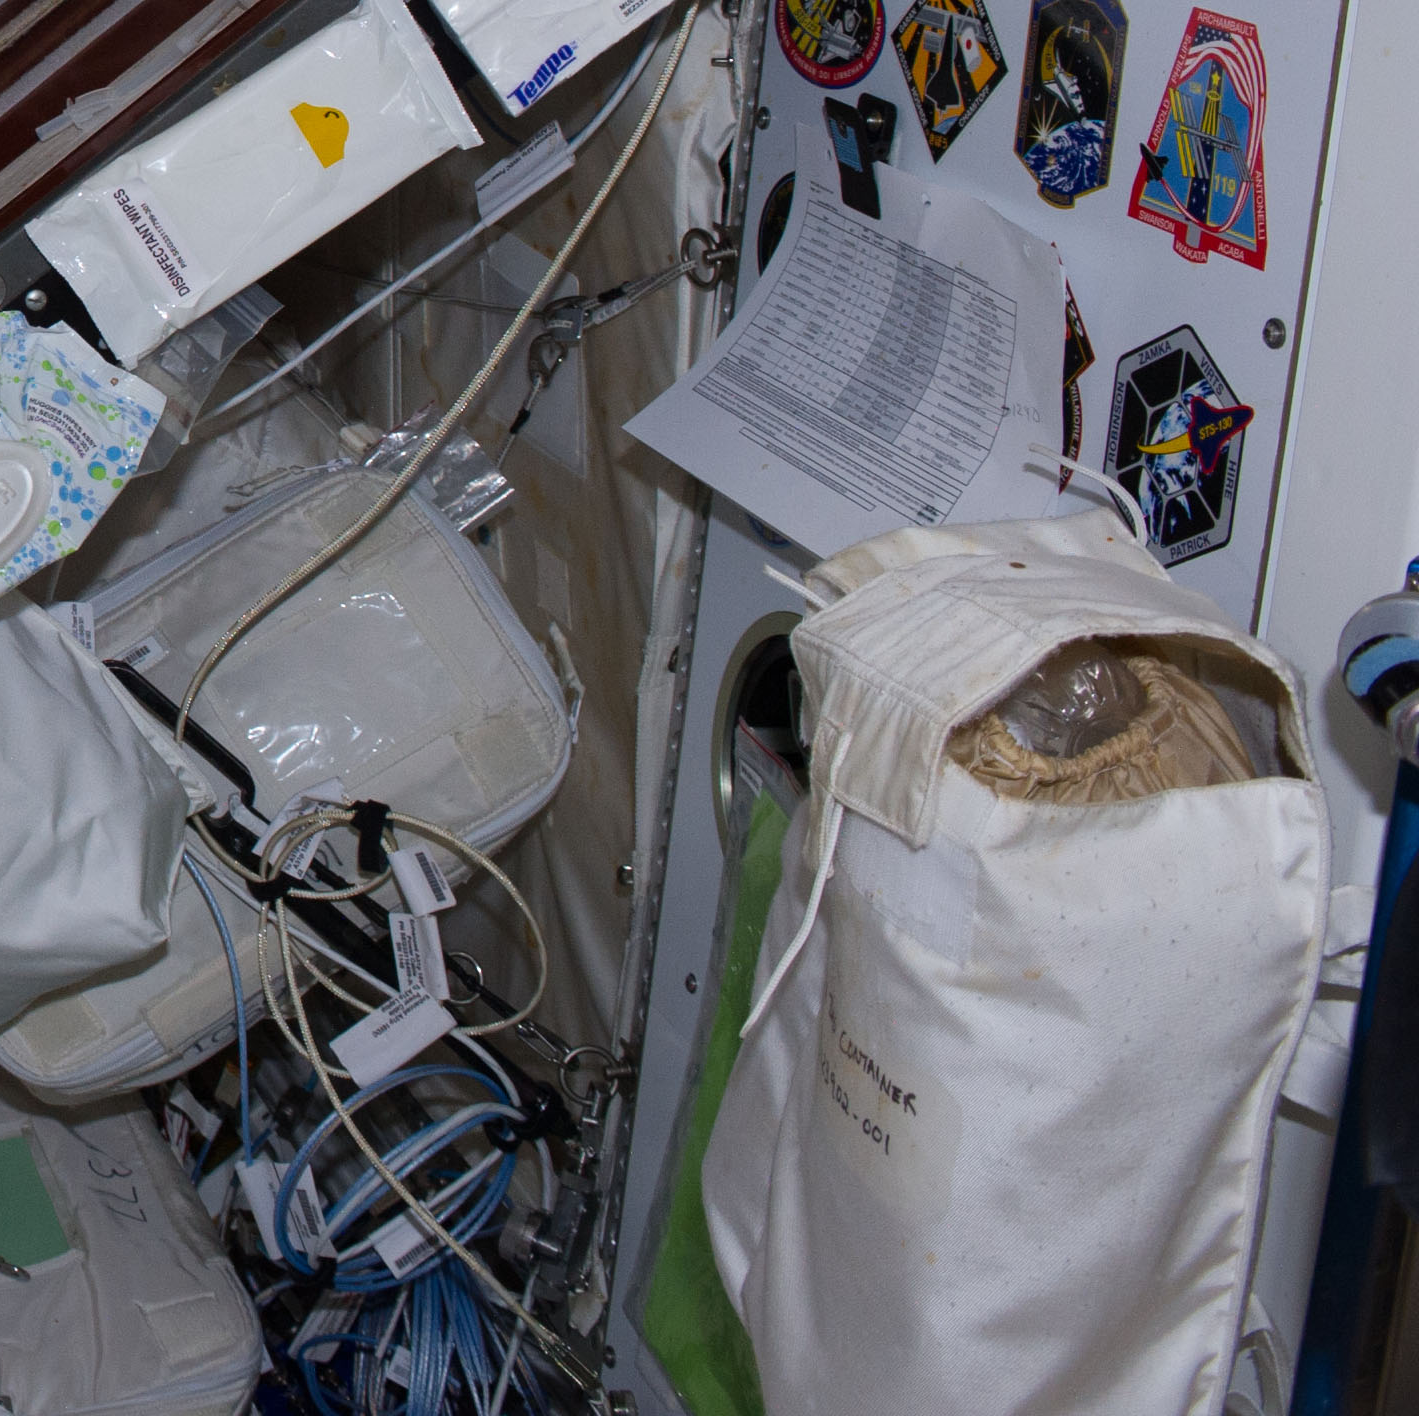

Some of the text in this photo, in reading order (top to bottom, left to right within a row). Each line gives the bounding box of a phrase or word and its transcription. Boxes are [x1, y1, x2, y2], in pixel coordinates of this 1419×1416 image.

[1197, 11, 1255, 37] ARCHAMBAULT
[506, 44, 576, 107] Tempo
[1171, 35, 1192, 83] PHILLIPS
[1151, 100, 1171, 145] ARNOLD
[1214, 174, 1236, 197] 119
[1253, 169, 1265, 240] ANTONELLI
[1139, 210, 1176, 234] SWANSON
[113, 188, 190, 297] DISINFECTANT WIPES
[1175, 243, 1207, 262] WAKATA
[1217, 242, 1245, 261] ACABA
[1137, 340, 1172, 366] ZAMKA
[1198, 356, 1225, 397] VIRTS
[29, 398, 62, 416] HUGGIES
[1108, 381, 1126, 464] ROBINSON
[1198, 415, 1233, 441] STS-130
[1224, 459, 1237, 500] HIRE
[1169, 534, 1210, 560] PATRICK
[838, 1031, 917, 1116] CONTAINER
